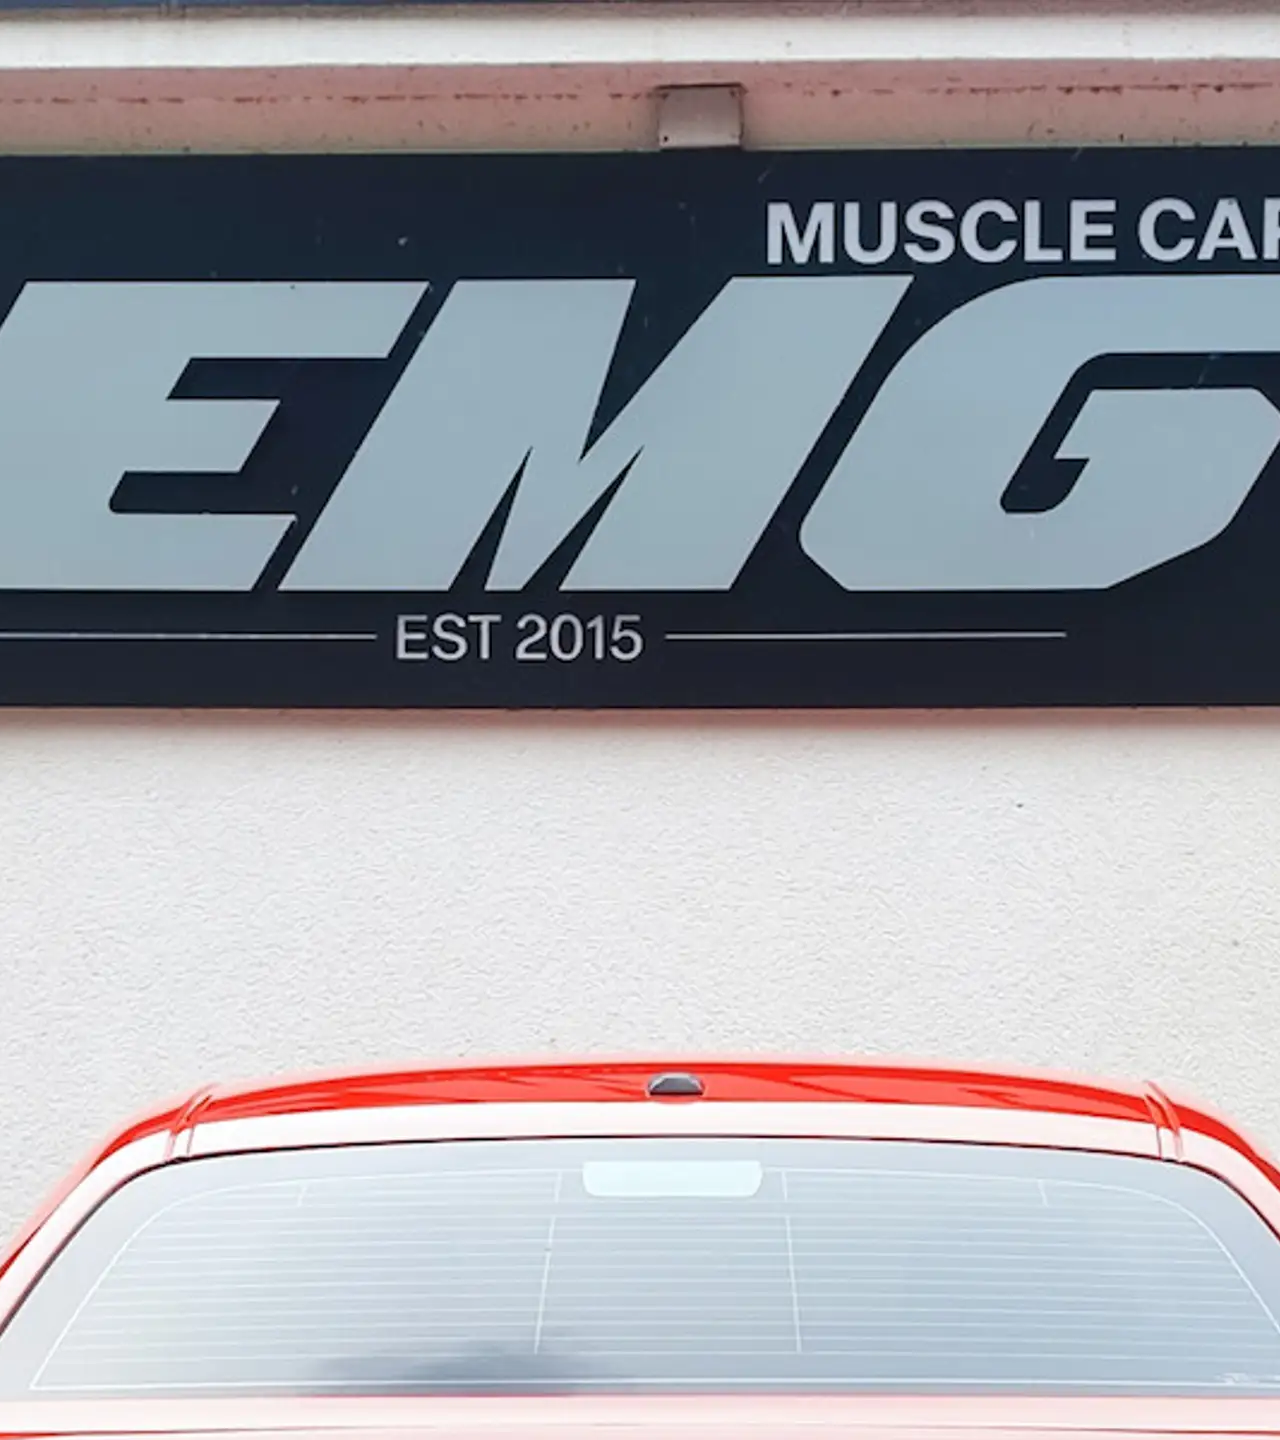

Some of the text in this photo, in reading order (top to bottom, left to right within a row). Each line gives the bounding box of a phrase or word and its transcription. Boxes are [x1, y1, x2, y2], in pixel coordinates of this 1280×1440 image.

[766, 198, 1117, 265] MUSCLE
[395, 613, 644, 662] EST 2015
